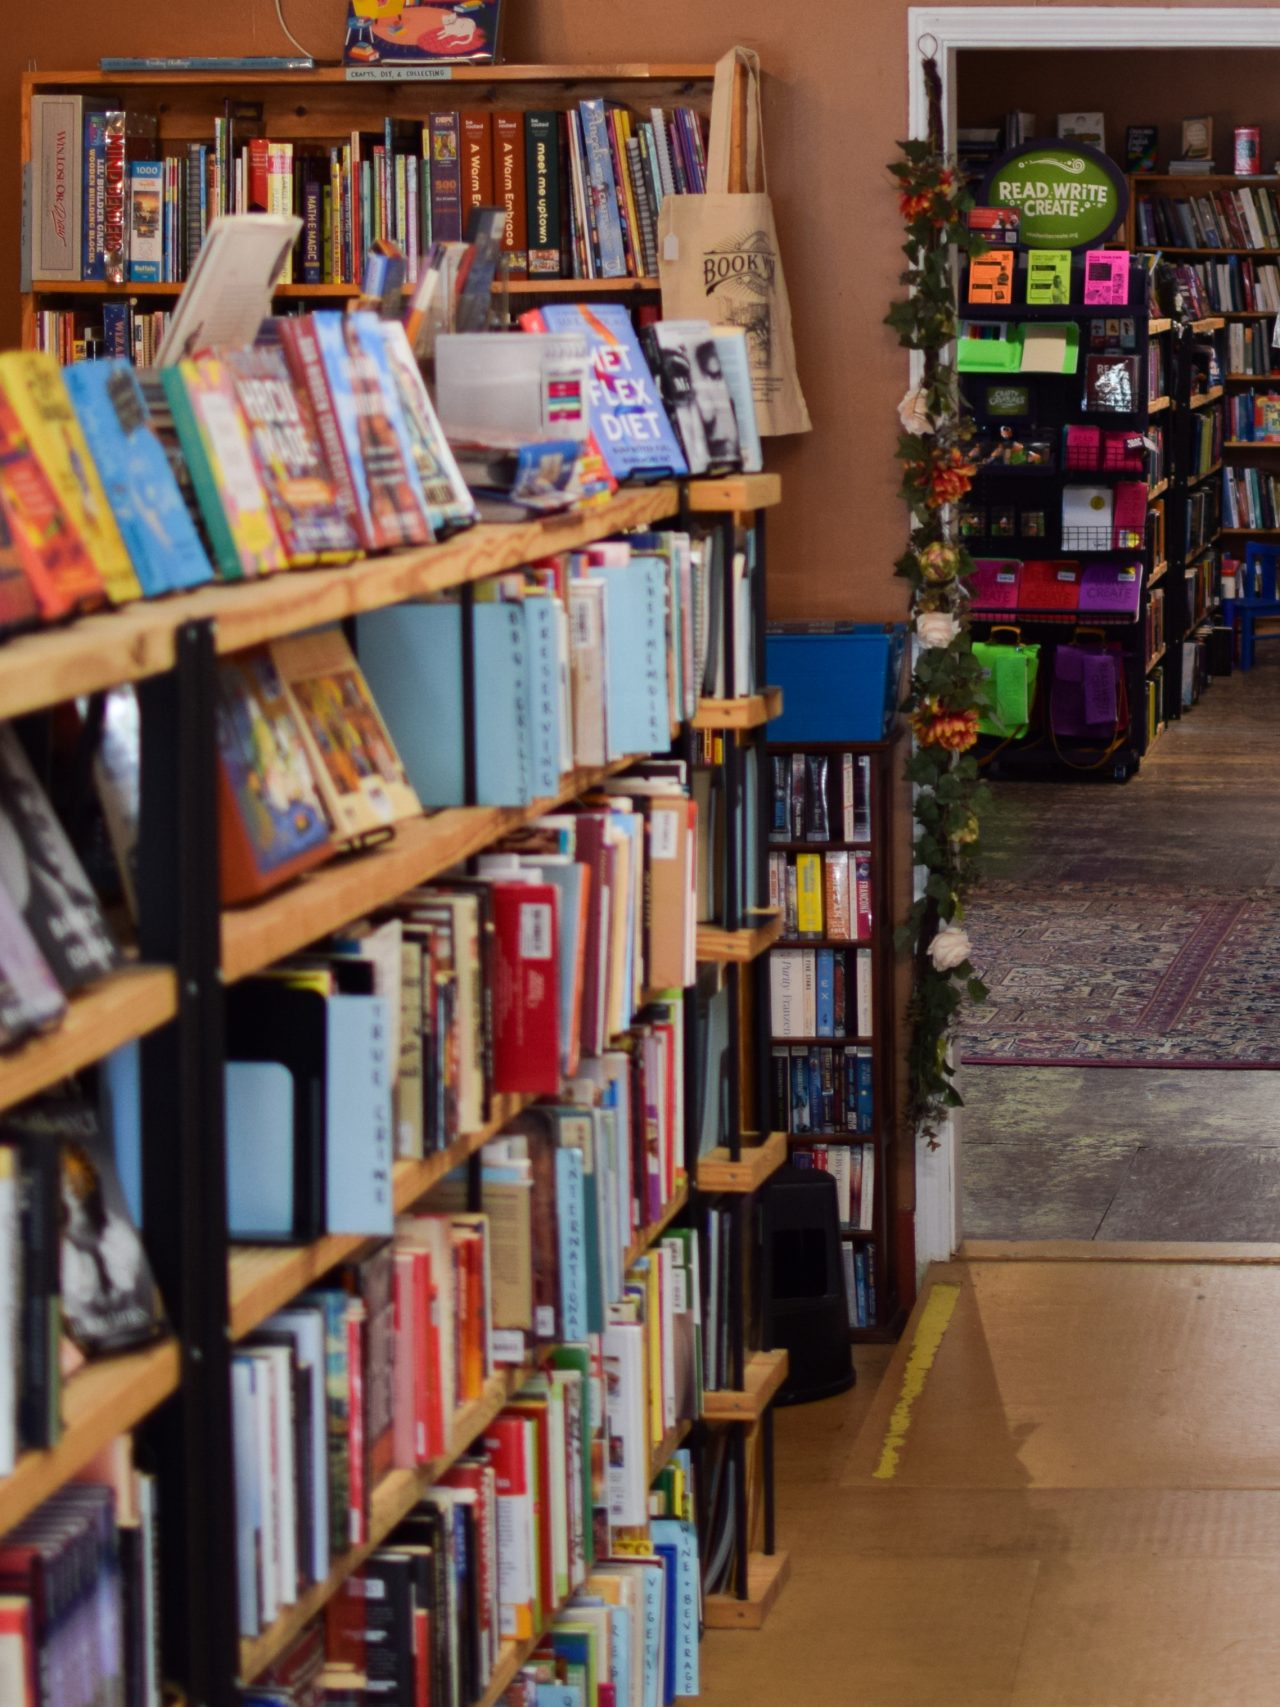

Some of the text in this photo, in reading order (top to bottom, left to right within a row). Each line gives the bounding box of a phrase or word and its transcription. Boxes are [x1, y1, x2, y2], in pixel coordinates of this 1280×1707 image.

[406, 69, 445, 78] COLLECTING
[136, 166, 158, 175] 1000
[470, 143, 480, 153] A
[471, 155, 481, 191] Warm
[88, 148, 96, 264] WOODEN BUILDING BLOCKS
[106, 133, 123, 252] MIND BENDERS
[503, 143, 515, 246] A Warm Embrace
[536, 142, 548, 244] meet me uptown
[999, 181, 1049, 200] READ
[1024, 200, 1080, 217] CREATE
[589, 378, 653, 408] FLEX
[599, 411, 661, 442] DIET
[538, 608, 552, 789] PRESERVING
[780, 961, 794, 1036] Purity Franzen
[567, 1152, 581, 1341] INTERNATIONAL
[679, 1521, 691, 1571] WINE
[683, 1594, 694, 1695] BEVERAGE
